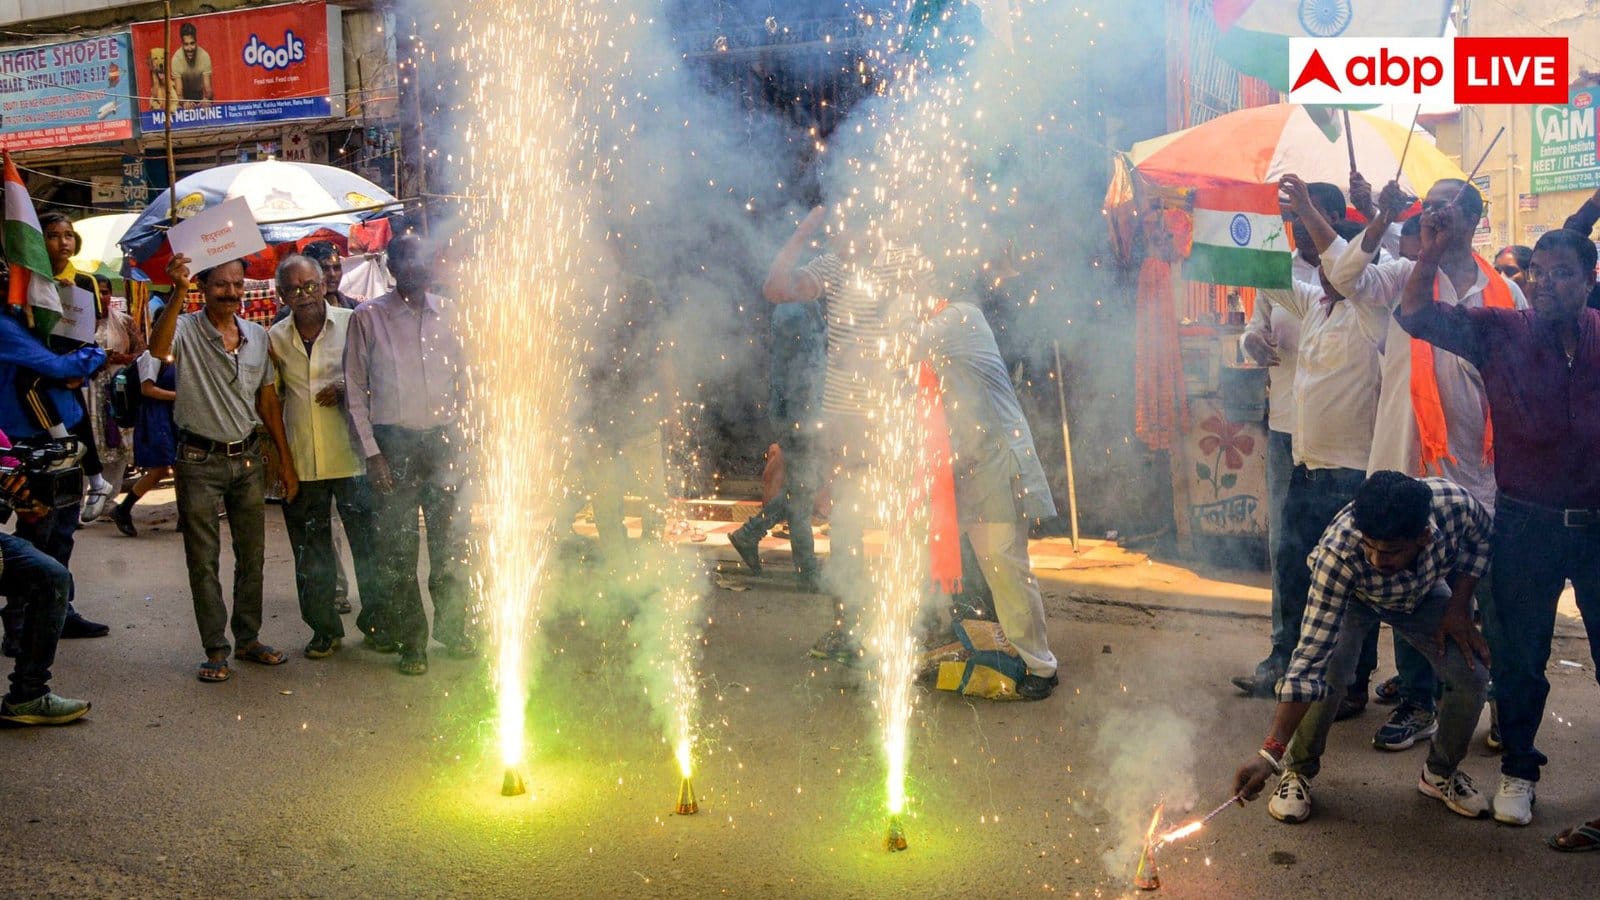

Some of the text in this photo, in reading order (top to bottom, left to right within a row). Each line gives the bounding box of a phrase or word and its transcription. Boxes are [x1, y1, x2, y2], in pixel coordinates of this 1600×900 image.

[0, 38, 119, 74] HARE SHOPEE
[243, 30, 305, 70] drools
[175, 106, 222, 123] MEDICINE
[286, 148, 306, 161] MAA
[1540, 141, 1595, 157] Entrance Institute
[1533, 158, 1555, 172] NEET
[1563, 153, 1595, 169] IIT-JEE
